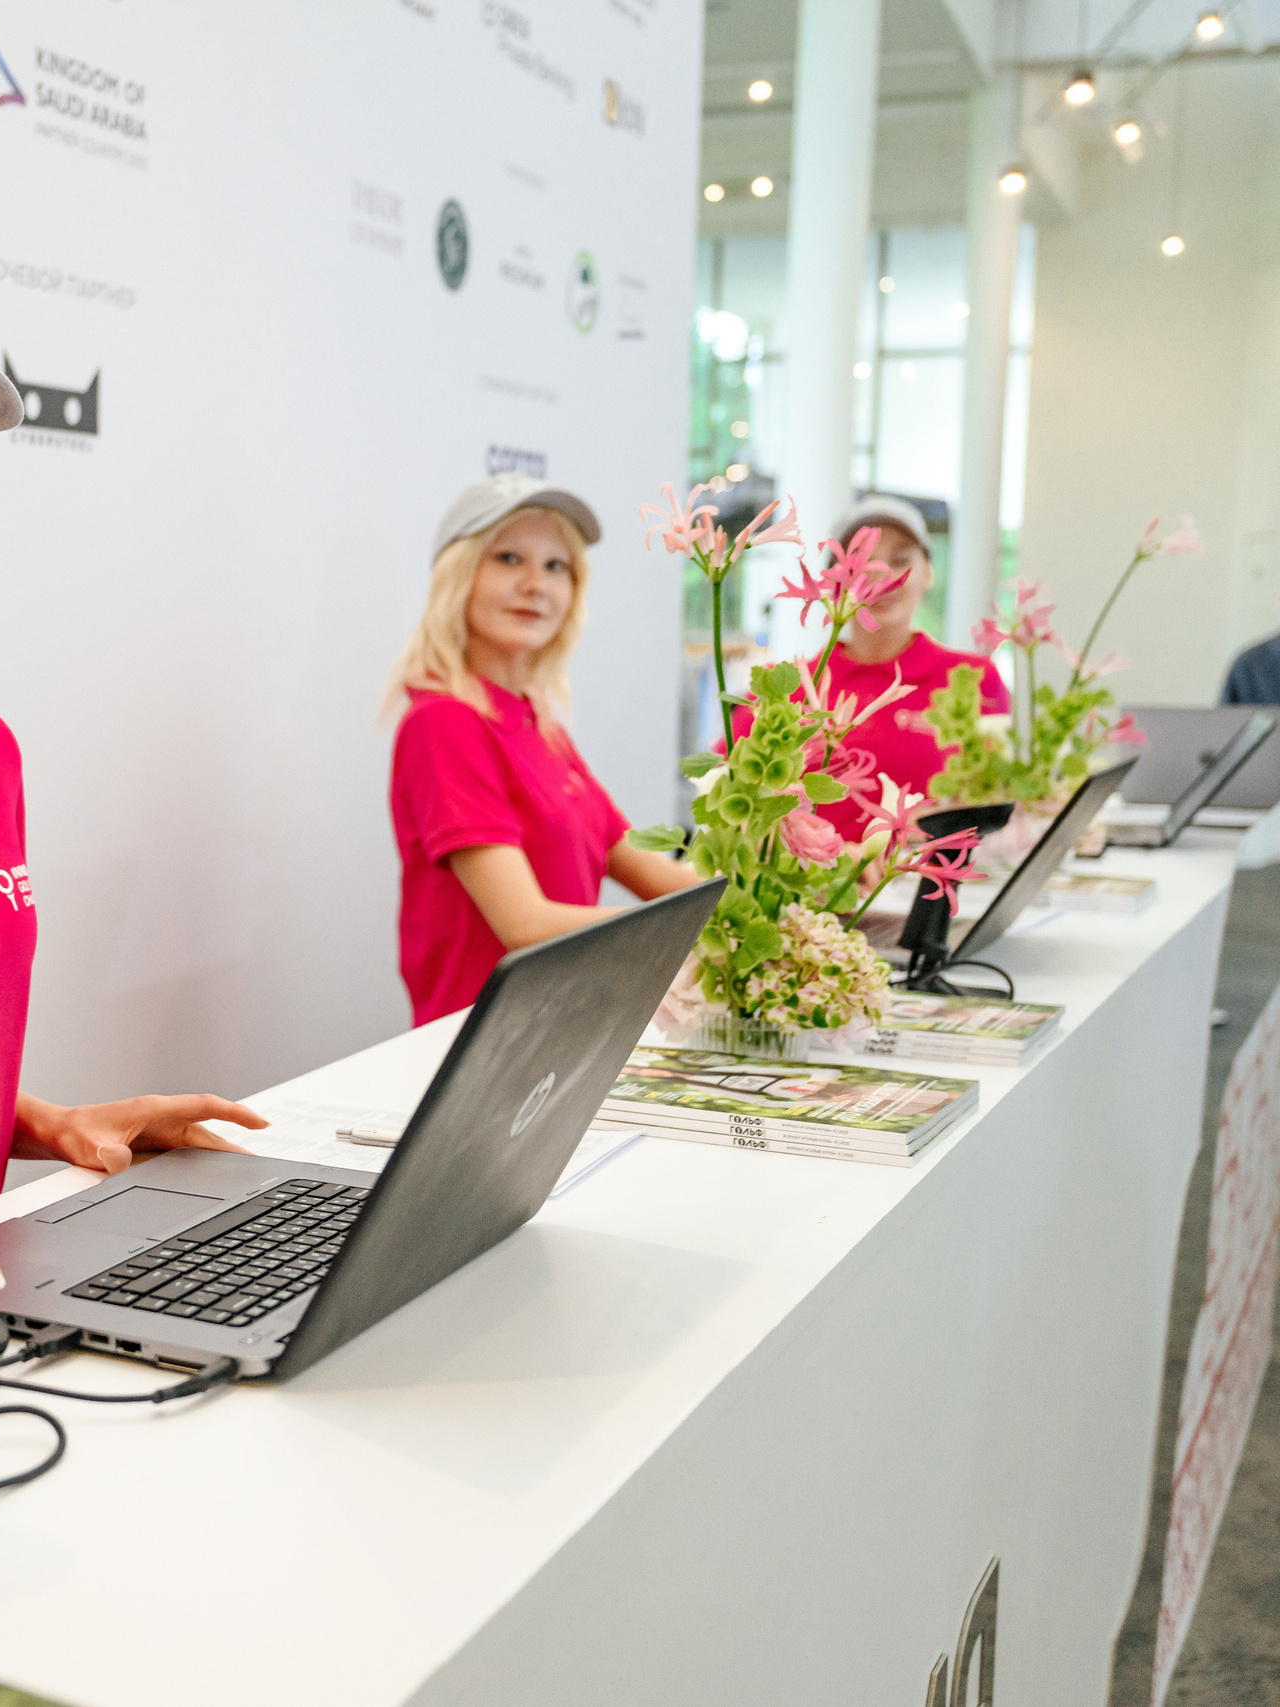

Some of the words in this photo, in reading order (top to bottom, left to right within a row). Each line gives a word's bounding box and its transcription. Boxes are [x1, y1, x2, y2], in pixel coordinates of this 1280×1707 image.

[36, 47, 120, 99] KINGDOM
[36, 81, 86, 120] SAUDI
[728, 1114, 762, 1126] ГОЛЬФ
[729, 1125, 764, 1137] ГОЛЬФ
[733, 1137, 767, 1149] ГОЛЬФ
